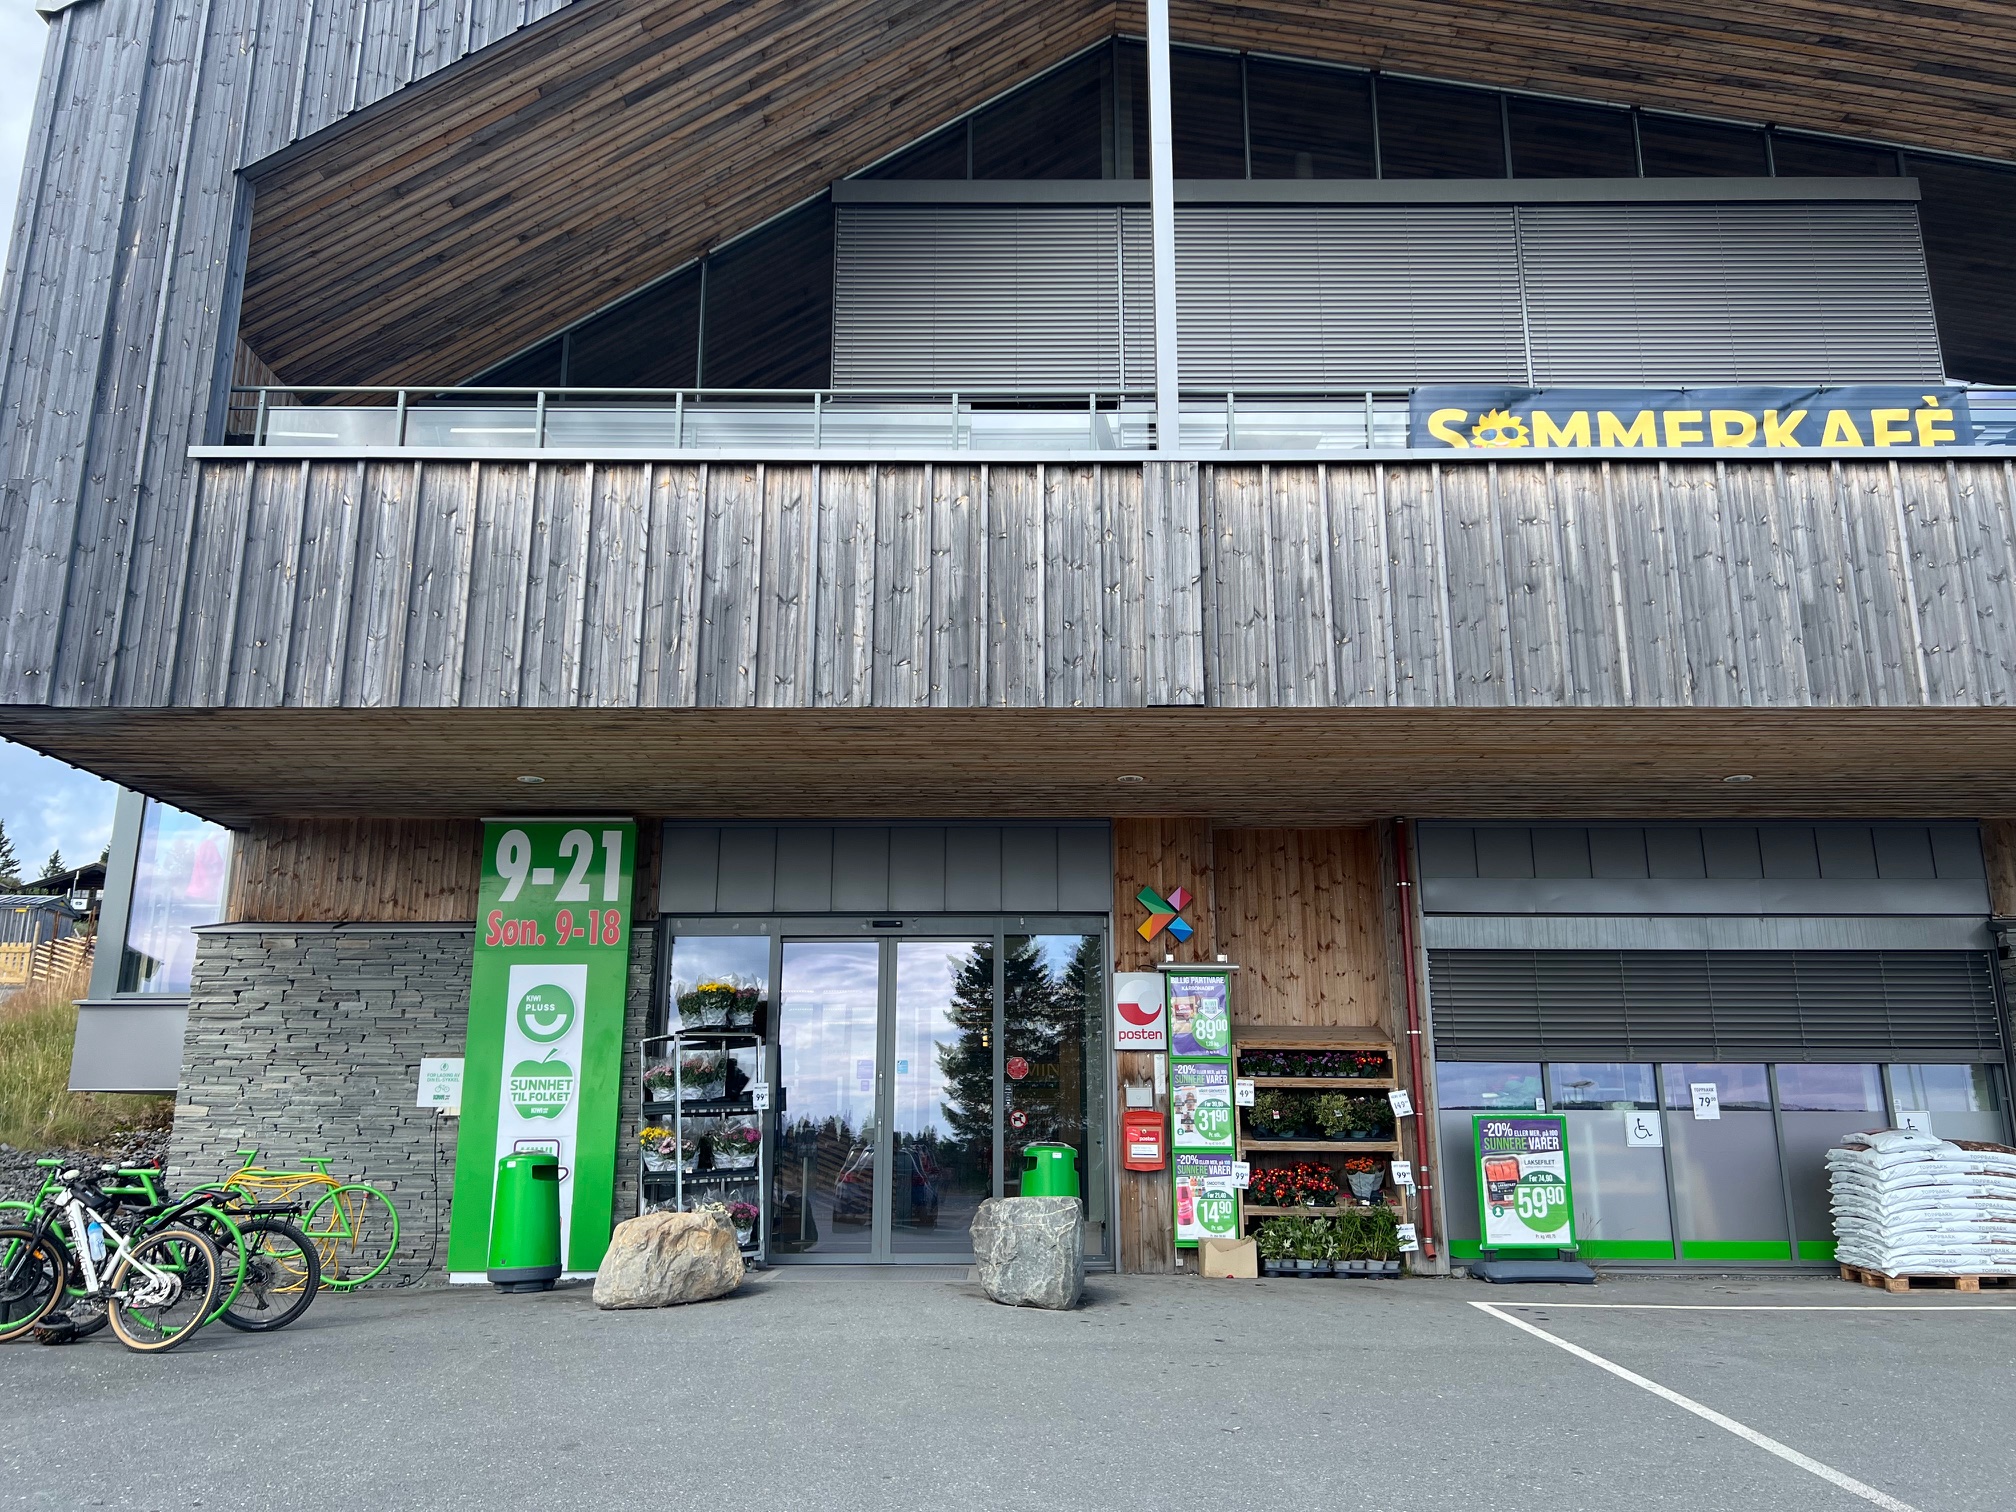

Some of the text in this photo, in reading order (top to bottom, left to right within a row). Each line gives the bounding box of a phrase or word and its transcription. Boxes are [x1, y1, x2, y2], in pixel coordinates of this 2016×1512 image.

[496, 829, 623, 902] 9-21
[485, 909, 621, 947] Søn. 9-18
[1170, 976, 1225, 984] BILLIG PARTIVARE
[1119, 1029, 1163, 1042] posten
[1174, 1064, 1196, 1074] -20%
[510, 1079, 573, 1091] SUNNHET
[1175, 1075, 1228, 1084] SUNNERE VARER
[511, 1092, 571, 1101] TIL FOLKET
[1483, 1122, 1513, 1137] -20%
[1484, 1137, 1559, 1150] SUNNERE VARER
[1177, 1155, 1199, 1165] -20%
[1177, 1165, 1231, 1175] SUNNERE VARER
